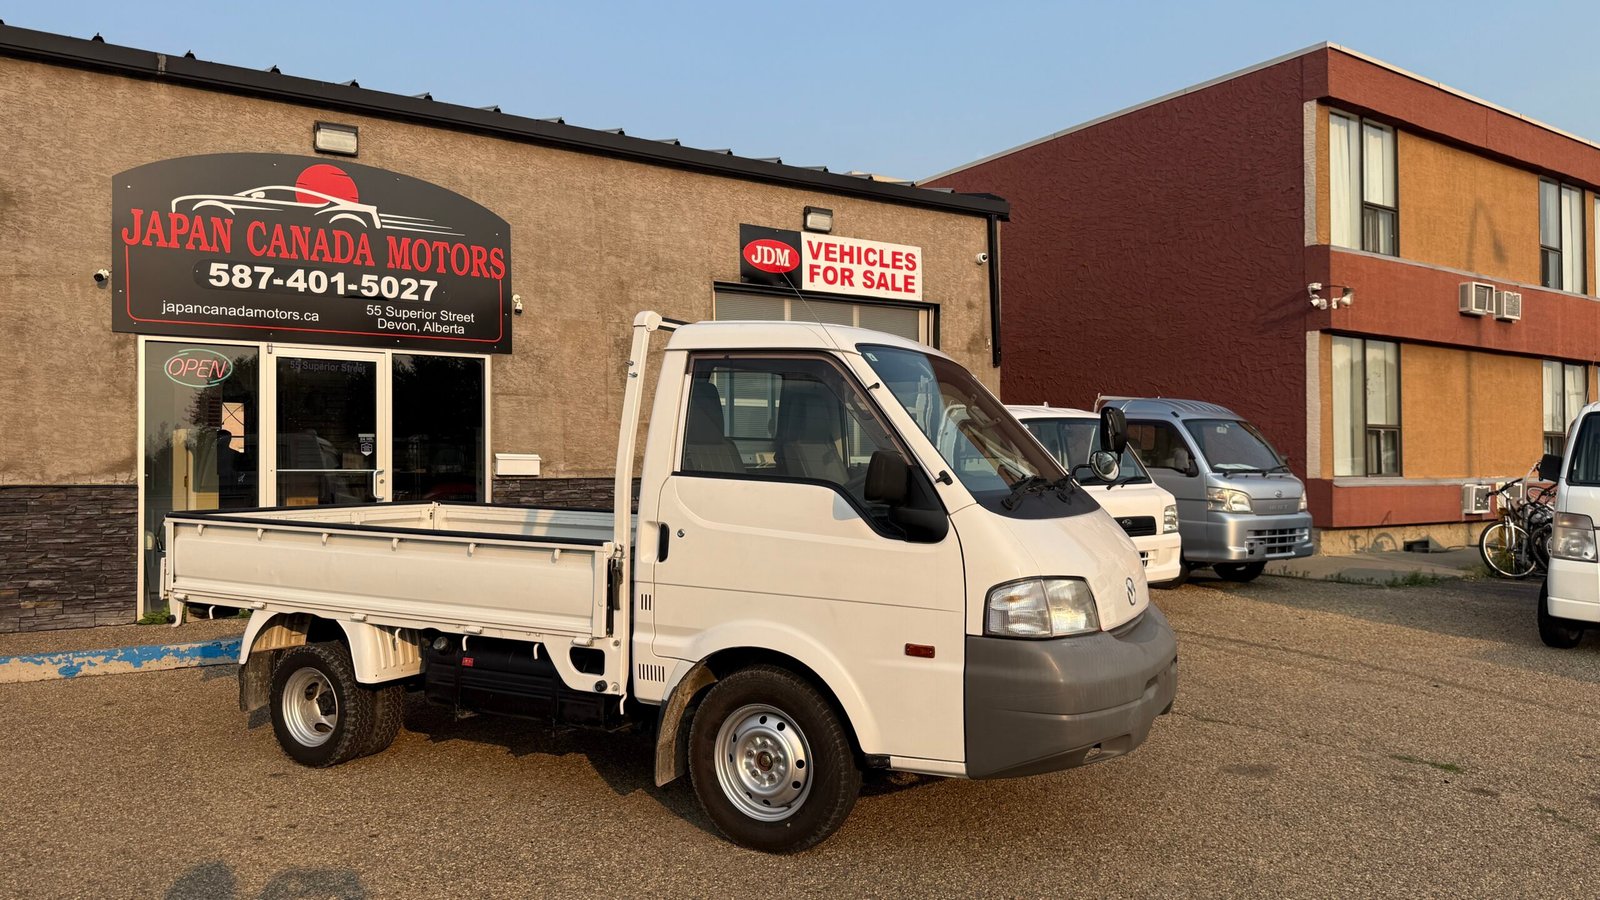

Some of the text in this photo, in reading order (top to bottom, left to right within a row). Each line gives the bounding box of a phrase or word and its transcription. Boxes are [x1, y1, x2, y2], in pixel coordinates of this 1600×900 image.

[122, 208, 506, 280] JAPAN CANADA MOTORS
[751, 245, 790, 267] JDM
[807, 240, 917, 271] VEHICLES
[208, 262, 438, 301] 587-401-5027
[809, 264, 916, 293] FOR SALE
[161, 300, 319, 322] japancanadamotors.ca
[366, 304, 475, 323] 55 Superior Street
[377, 318, 465, 334] Devon, Alberta
[168, 358, 227, 378] OPEN
[302, 361, 339, 372] Superior
